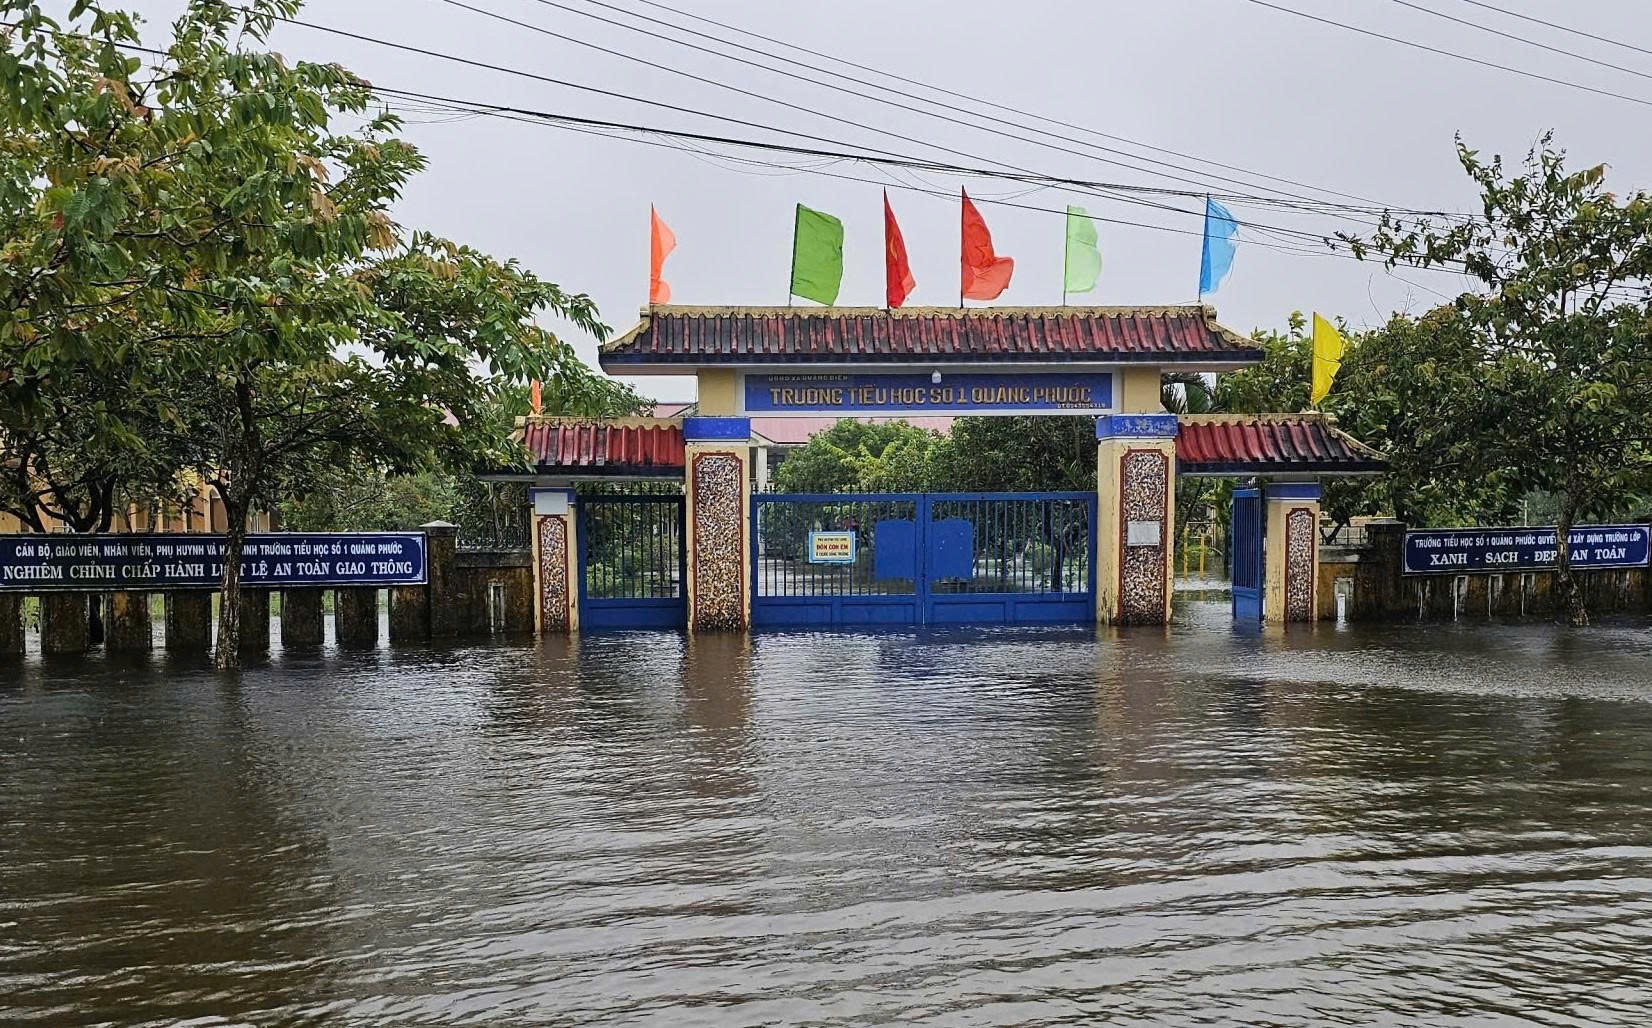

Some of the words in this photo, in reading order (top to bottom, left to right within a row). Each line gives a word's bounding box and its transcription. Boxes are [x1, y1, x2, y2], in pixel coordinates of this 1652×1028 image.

[891, 387, 926, 408] HỌC
[957, 387, 968, 404] 1
[15, 542, 34, 557] CÁN
[38, 543, 54, 560] BỘ,
[55, 543, 76, 557] GIÁO
[78, 543, 101, 558] VIÊN,
[104, 542, 128, 557] NHÂN
[131, 542, 154, 558] VIÊN,
[156, 545, 173, 559] PHỤ
[176, 545, 204, 556] HUYNH
[206, 542, 217, 556] VÀ
[260, 542, 291, 556] TRƯỜNG
[294, 540, 312, 556] TIỂU
[313, 544, 329, 558] HỌC
[331, 540, 342, 555] SỐ
[343, 544, 348, 555] 1
[350, 541, 375, 555] QUẢNG
[378, 542, 403, 555] PHƯỚC
[1415, 536, 1442, 548] TRƯỜNG
[1443, 534, 1459, 547] TIỂU
[1460, 537, 1473, 549] HỌC
[1475, 534, 1485, 547] SỐ
[1486, 538, 1490, 546] 1
[1491, 534, 1513, 546] QUẢNG
[1605, 532, 1629, 543] TRƯỜNG
[1630, 530, 1641, 542] LỚP
[1429, 553, 1468, 565] XANH
[1485, 552, 1519, 566] SẠCH
[1534, 550, 1558, 564] ĐẸP
[1570, 549, 1589, 561] AN
[1595, 545, 1626, 560] TOÀN
[3, 562, 64, 580] NGHIÊM
[69, 560, 116, 579] CHỈNH
[122, 559, 160, 579] CHẤP
[164, 560, 205, 577] HÀNH
[211, 563, 247, 577] LT
[251, 560, 268, 579] LỆ
[273, 562, 292, 576] AN
[296, 559, 330, 576] TOÀN
[336, 561, 366, 576] GIAO
[371, 558, 413, 575] THÔNG
